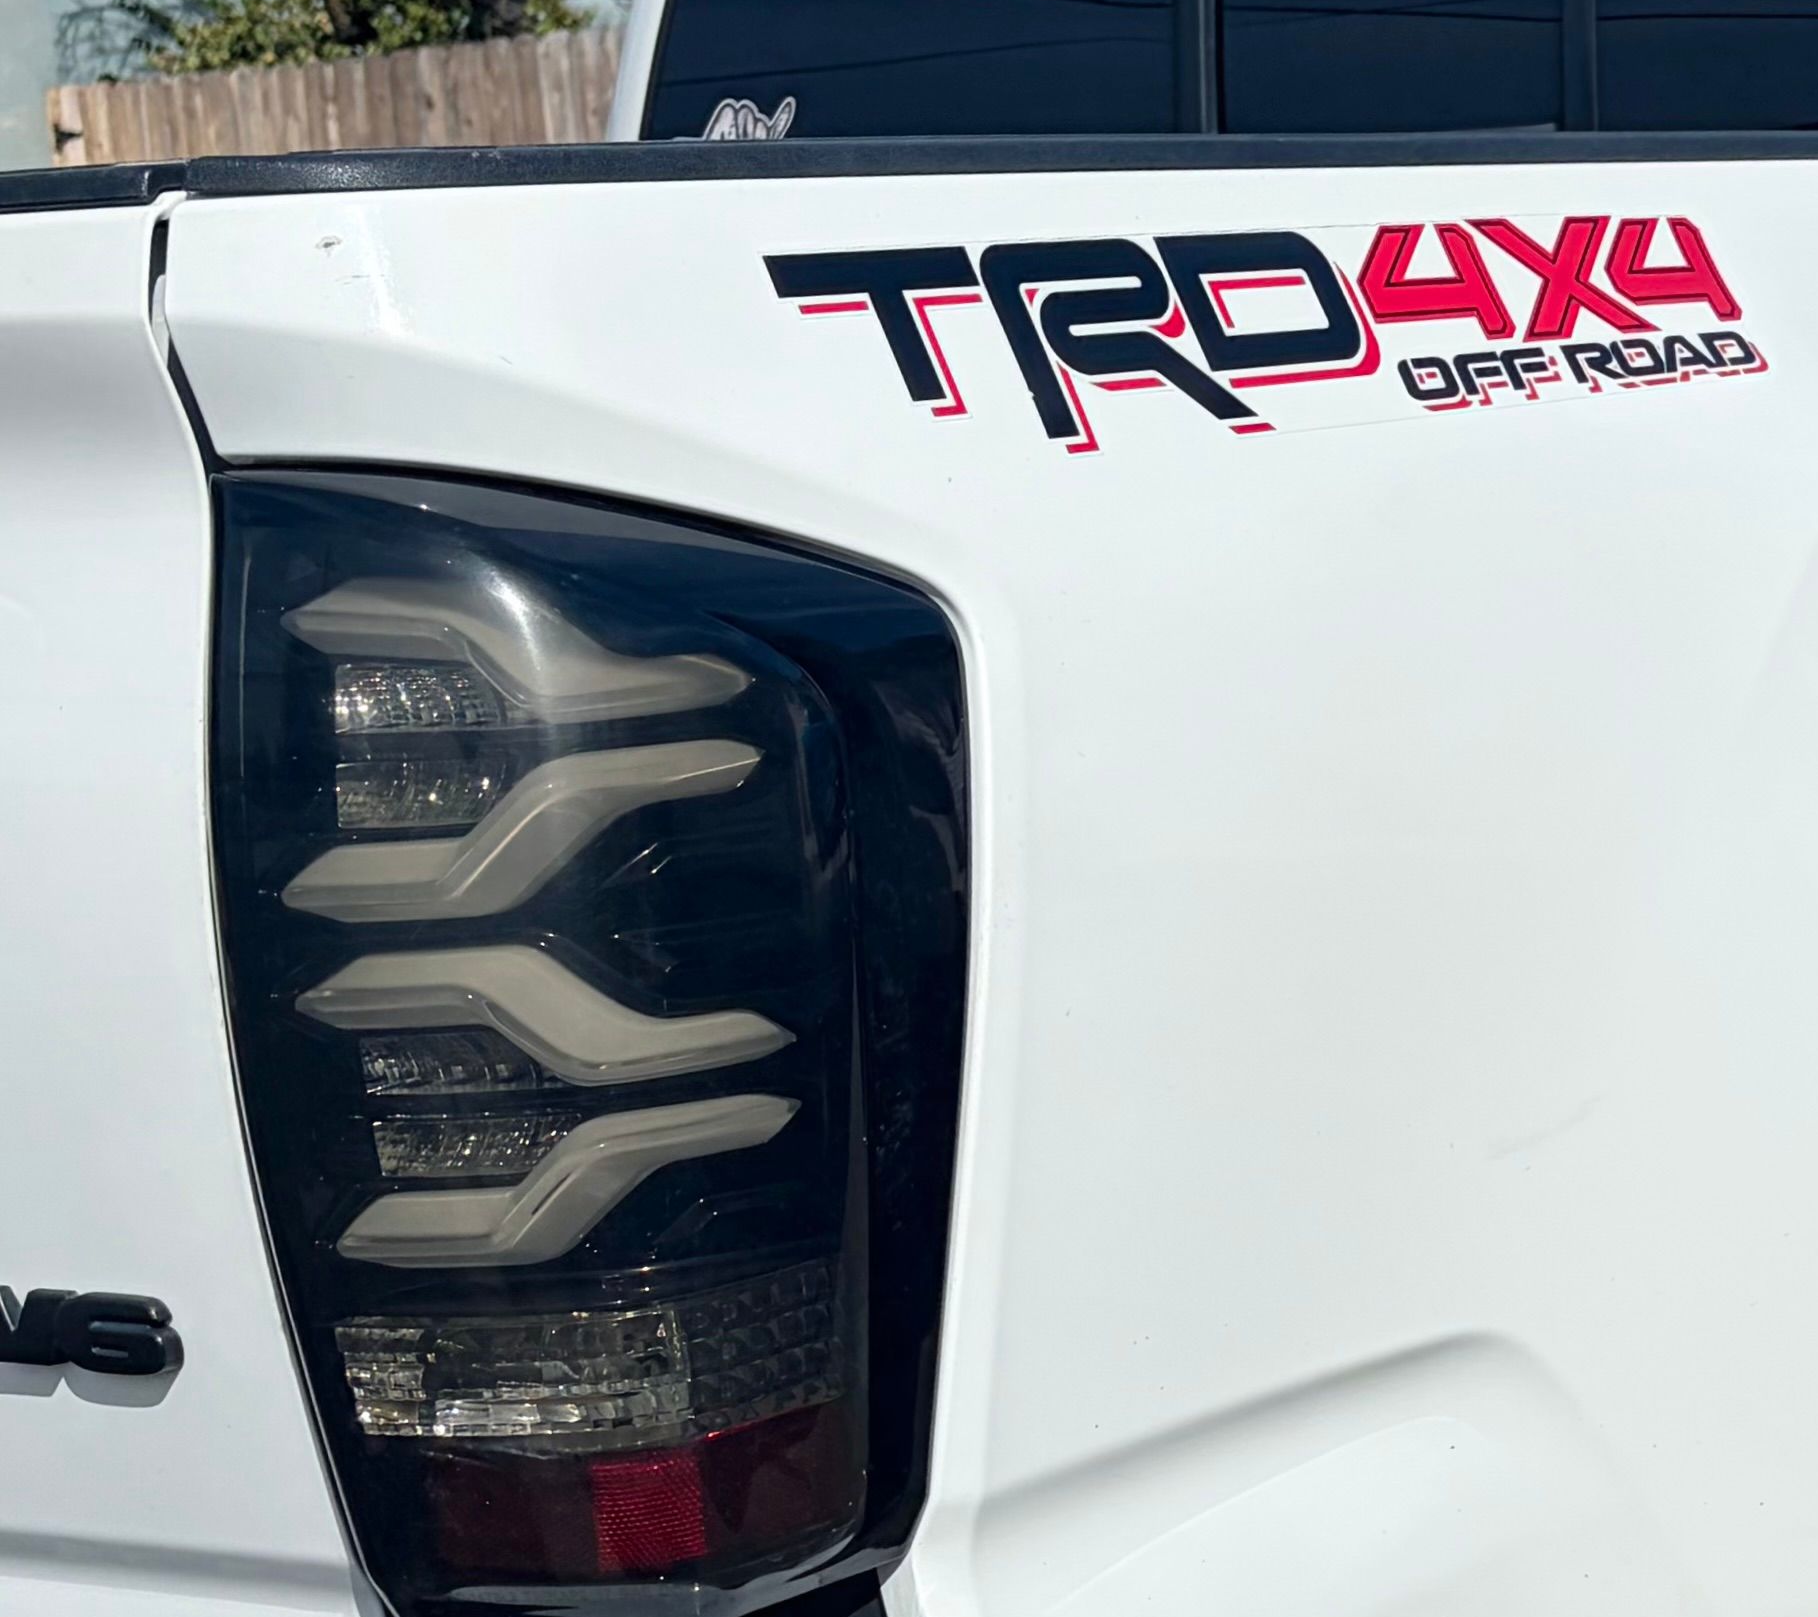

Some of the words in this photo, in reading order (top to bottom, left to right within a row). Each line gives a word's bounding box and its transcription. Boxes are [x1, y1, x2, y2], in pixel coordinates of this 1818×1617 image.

[762, 231, 1378, 452] TRD
[1357, 215, 1743, 342] 4X4
[1397, 346, 1558, 408] OFF
[1559, 330, 1766, 390] ROAD
